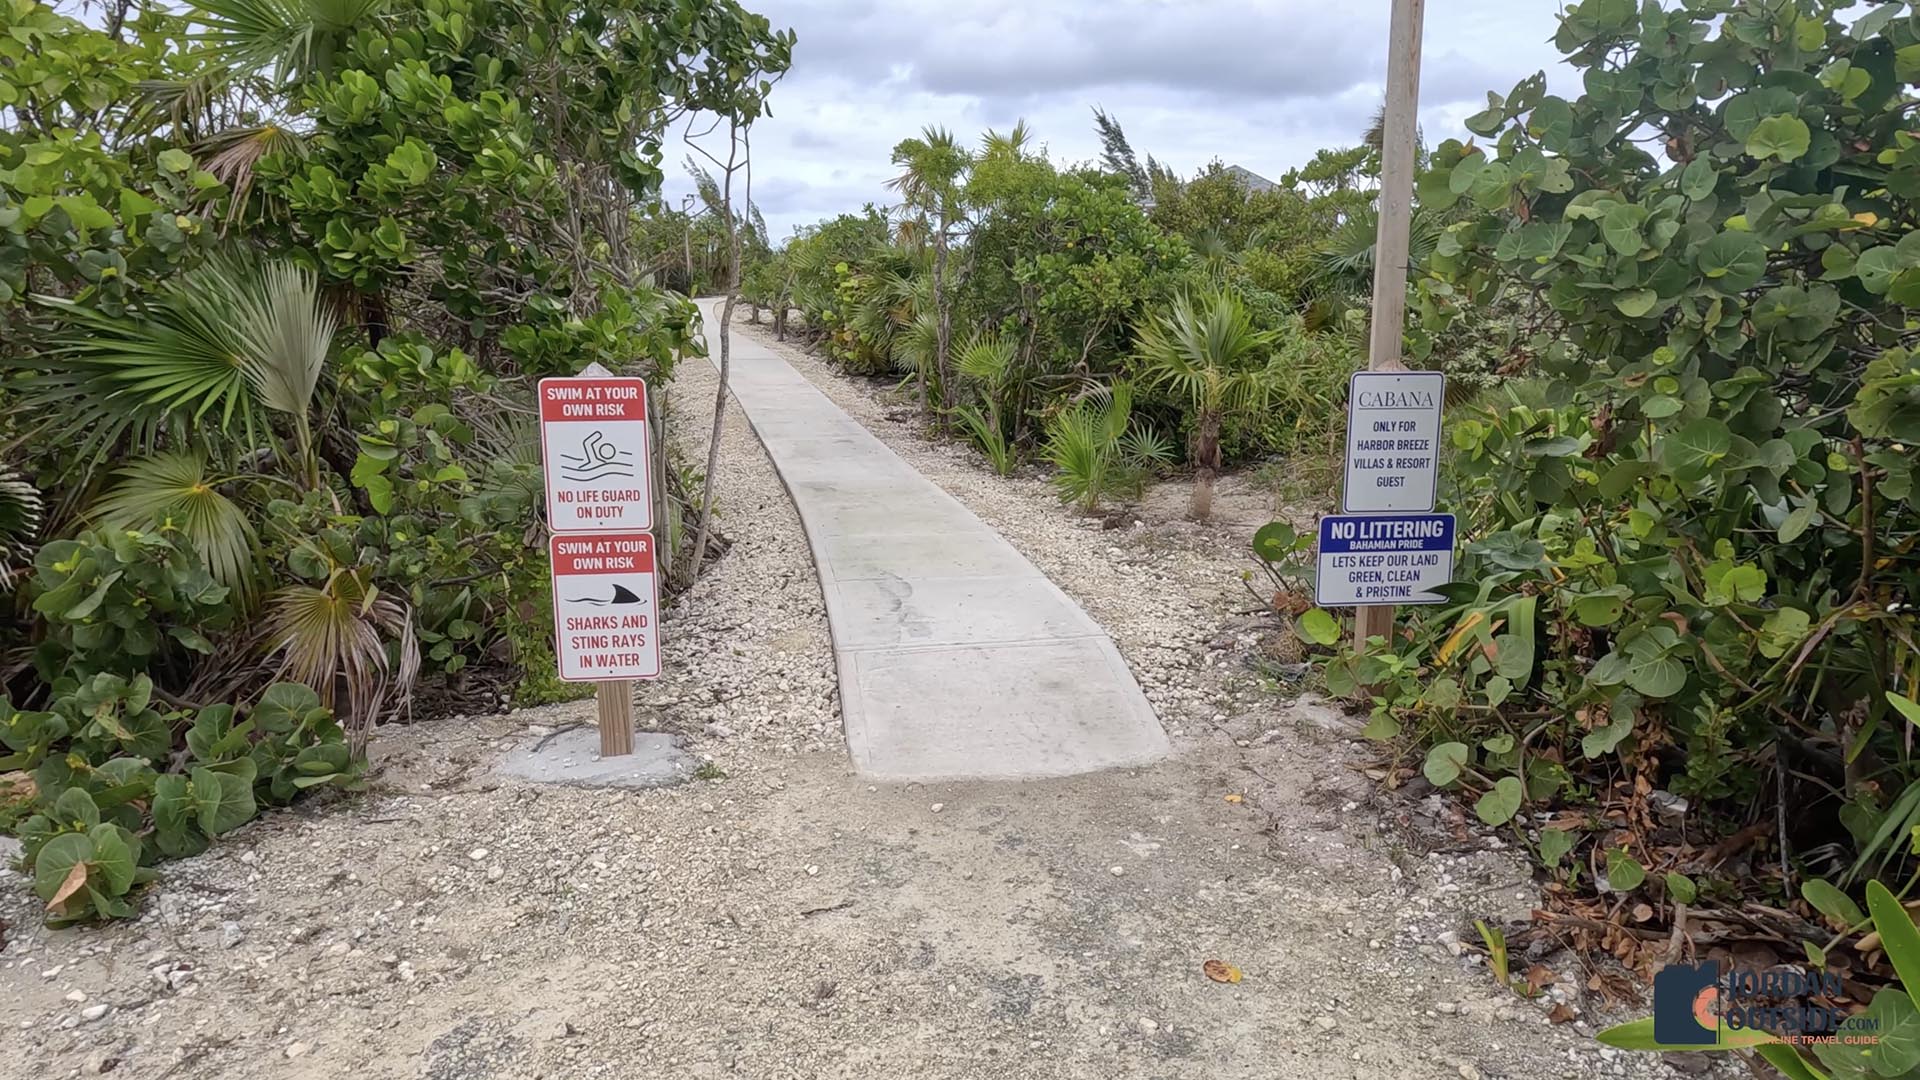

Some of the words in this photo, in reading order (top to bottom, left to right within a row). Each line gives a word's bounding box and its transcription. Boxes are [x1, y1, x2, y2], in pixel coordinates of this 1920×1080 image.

[547, 388, 582, 400] SWIM
[586, 388, 602, 399] AT
[604, 387, 638, 399] YOUR
[1359, 391, 1434, 407] CABANA
[563, 404, 592, 416] OWN
[596, 404, 625, 415] RISK
[1373, 421, 1396, 432] ONLY
[1399, 421, 1417, 432] FOR
[1357, 440, 1395, 450] HARBOR
[1397, 440, 1429, 450] BREEZE
[1354, 458, 1385, 469] VILLAS
[1387, 458, 1393, 469] &
[1396, 458, 1431, 469] RESORT
[1376, 476, 1405, 487] GUEST
[558, 491, 573, 503] NO
[577, 491, 599, 502] LIFE
[602, 490, 640, 502] GUARD
[577, 507, 592, 518] ON
[596, 506, 624, 518] DUTY
[1331, 522, 1355, 539] NO
[1360, 520, 1444, 539] LITTERING
[558, 543, 593, 555] SWIM
[596, 542, 612, 553] AT
[614, 541, 647, 553] YOUR
[1349, 540, 1397, 550] BAHAMIAN
[1398, 539, 1424, 549] PRIDE
[573, 558, 603, 570] OWN
[606, 557, 634, 569] RISK
[1332, 556, 1356, 568] LETS
[1359, 555, 1384, 567] KEEP
[1387, 555, 1408, 567] OUR
[1411, 554, 1438, 566] LAND
[1349, 571, 1385, 584] GREEN,
[1387, 570, 1420, 582] CLEAN
[1355, 587, 1362, 598] &
[1366, 585, 1411, 598] PRISTINE
[566, 616, 618, 630] SHARKS
[622, 615, 648, 629] AND
[572, 635, 608, 650] STING
[612, 634, 645, 648] RAYS
[580, 655, 592, 668] IN
[596, 653, 640, 667] WATER
